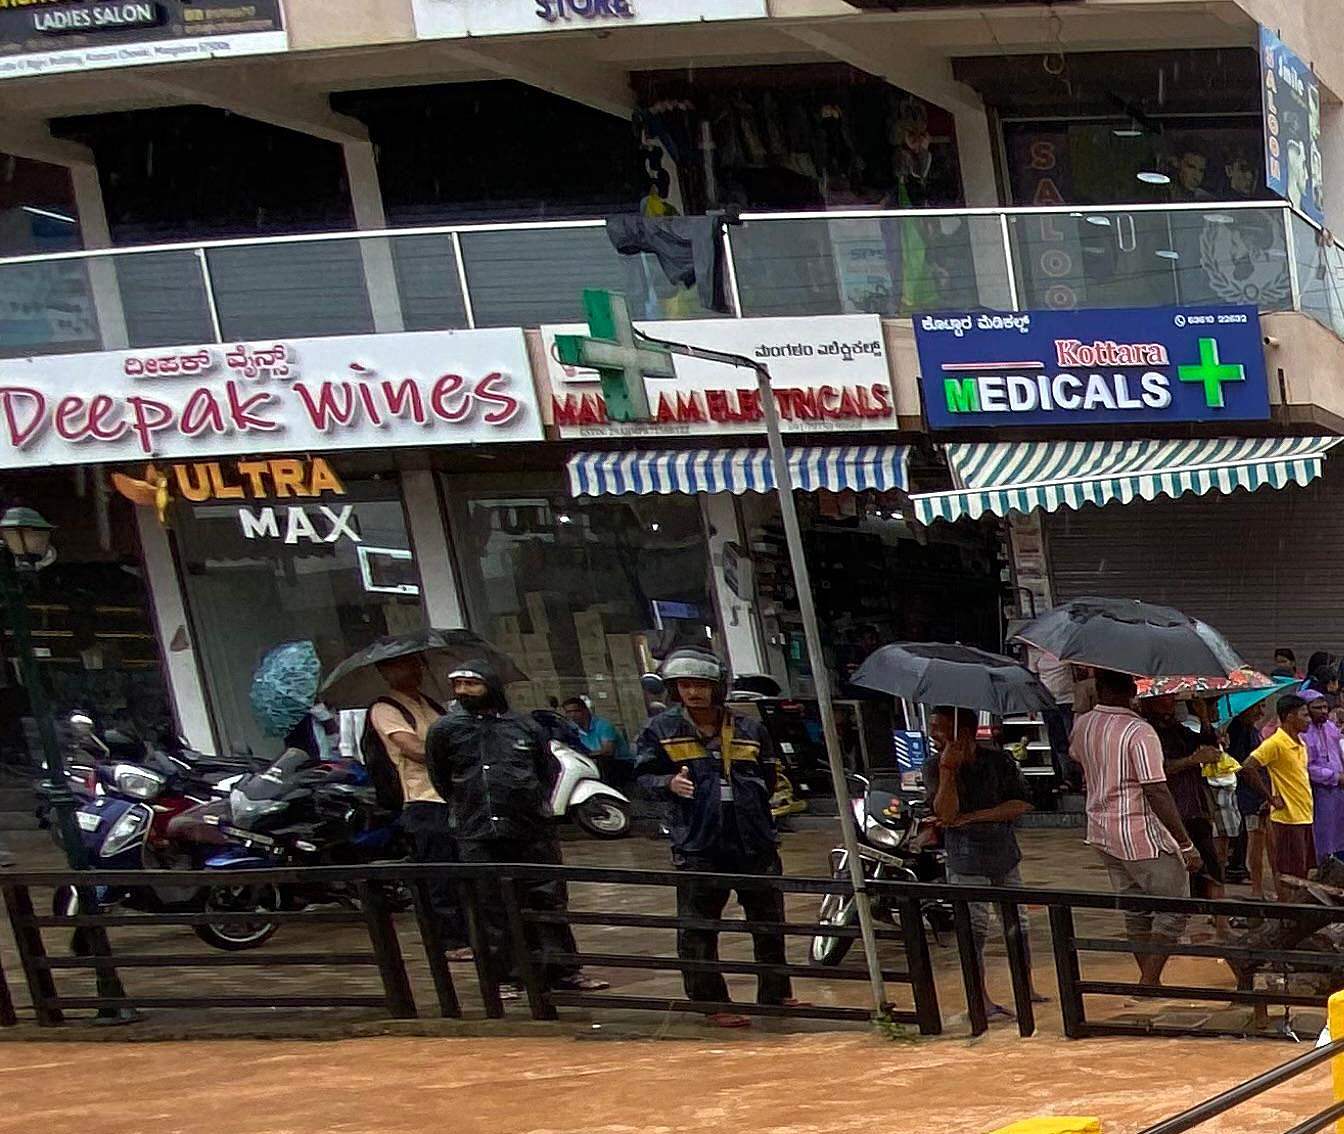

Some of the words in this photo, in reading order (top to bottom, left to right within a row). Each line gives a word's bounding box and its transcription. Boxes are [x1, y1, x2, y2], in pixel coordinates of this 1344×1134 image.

[34, 8, 90, 30] LADIES
[93, 4, 151, 26] SALON
[1054, 339, 1168, 367] Kottara
[0, 380, 278, 454] Deepak
[293, 362, 520, 432] wines
[944, 372, 1172, 413] MEDICALS
[174, 454, 346, 502] ULTRA
[239, 503, 363, 545] MAX
